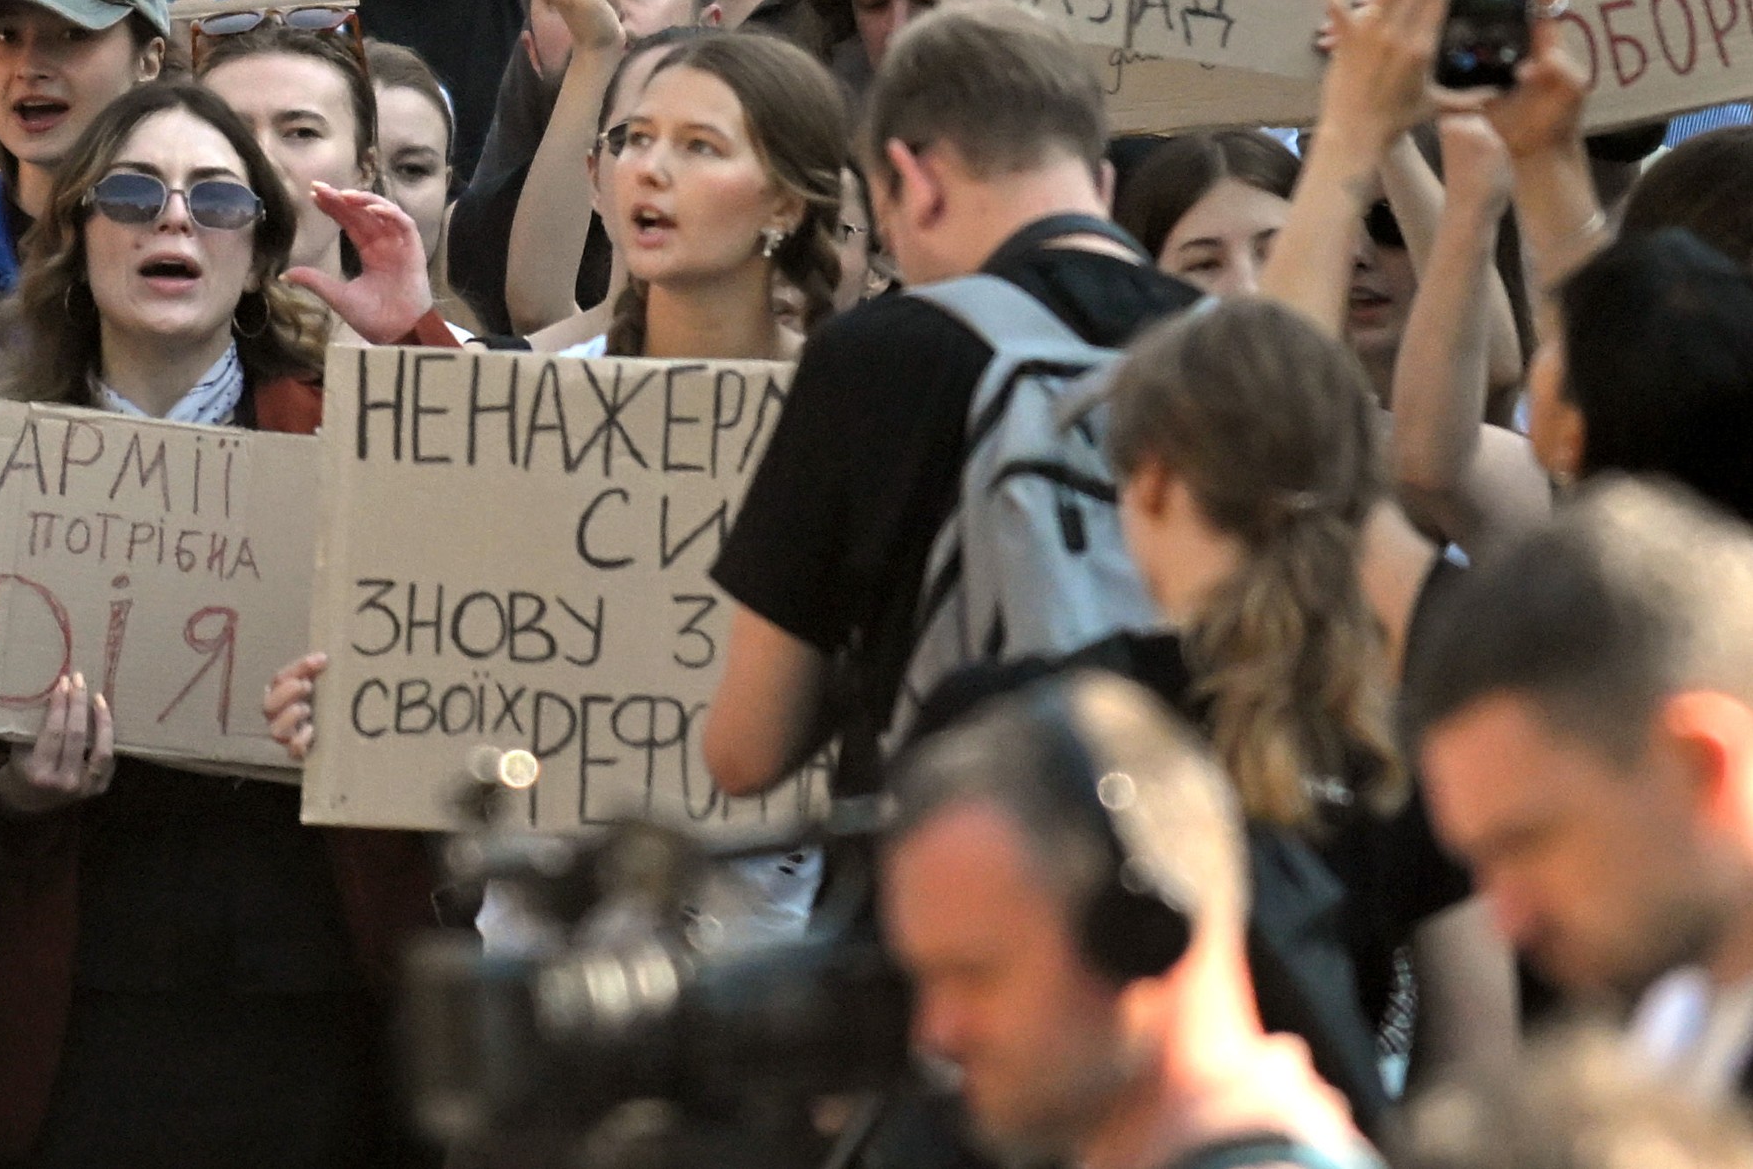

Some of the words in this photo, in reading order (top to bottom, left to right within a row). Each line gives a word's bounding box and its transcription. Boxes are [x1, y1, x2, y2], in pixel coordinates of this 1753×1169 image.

[28, 511, 262, 581] ПОТРІБНА
[351, 578, 604, 668] ЗНОВУ
[351, 671, 525, 739] СВОЇХ
[530, 695, 838, 828] РЕФО
